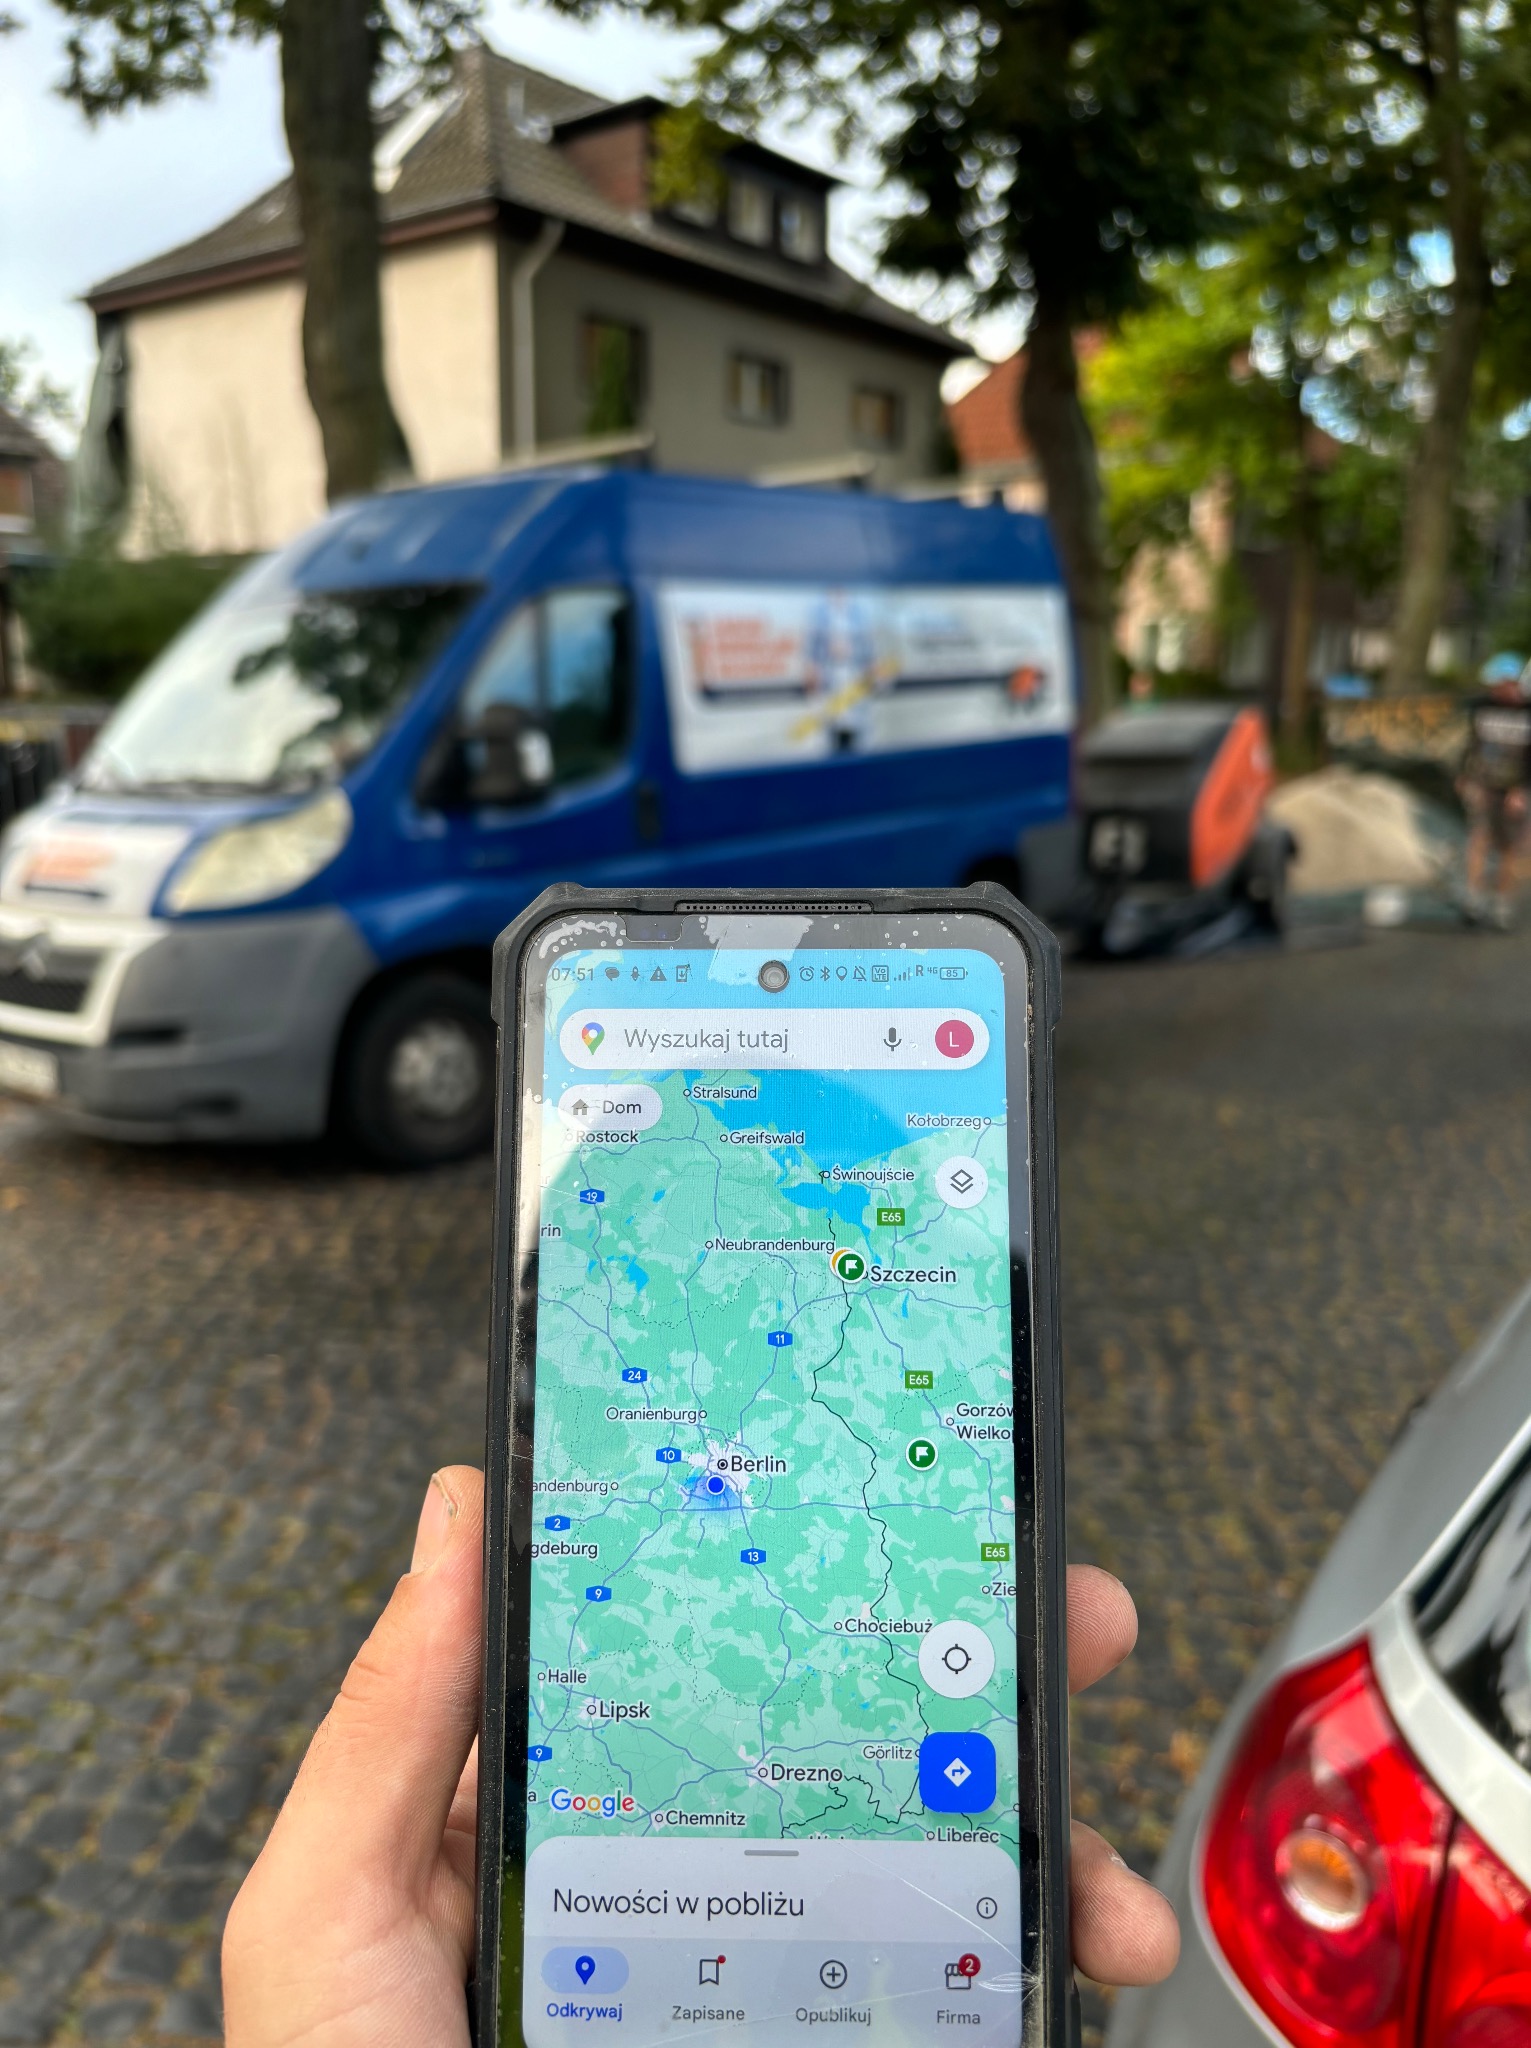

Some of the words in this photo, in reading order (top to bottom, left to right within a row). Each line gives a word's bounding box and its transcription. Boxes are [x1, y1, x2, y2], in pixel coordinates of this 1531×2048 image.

[551, 967, 594, 982] 07:51
[946, 969, 958, 978] 85
[624, 1028, 730, 1054] Wyszukaj
[737, 1028, 789, 1054] tutaj
[949, 1031, 960, 1048] L
[693, 1085, 757, 1099] Stralsund
[602, 1100, 642, 1114] Dom
[907, 1114, 982, 1129] Kołobrzeg
[576, 1130, 639, 1143] Rostock
[730, 1130, 804, 1145] Greifswald
[832, 1165, 915, 1184] Świnoujście
[586, 1191, 598, 1202] 19
[881, 1212, 902, 1223] E65
[715, 1236, 835, 1254] Neubrandenburg
[870, 1264, 957, 1285] Szczecin
[775, 1333, 785, 1344] 11
[628, 1370, 642, 1381] 24
[909, 1374, 930, 1386] E65
[606, 1406, 697, 1422] Oranienburg
[956, 1425, 1014, 1443] Wielko
[662, 1450, 675, 1461] 10
[731, 1455, 786, 1473] Berlin
[553, 1518, 561, 1529] 2
[748, 1551, 759, 1562] 13
[985, 1547, 1006, 1558] E65
[595, 1589, 602, 1599] 9
[845, 1618, 932, 1633] Chociebuż
[548, 1669, 587, 1684] Halle
[600, 1701, 650, 1722] Lipsk
[535, 1748, 543, 1759] 9
[863, 1745, 913, 1759] Görlitz
[772, 1765, 843, 1782] Drezno
[551, 1788, 635, 1818] Google
[666, 1810, 746, 1826] Chemnitz
[938, 1827, 999, 1843] Liberec
[553, 1889, 668, 1915] Nowości
[676, 1897, 699, 1915] w
[707, 1889, 804, 1921] pobliżu
[965, 1959, 974, 1973] 2
[546, 2003, 623, 2021] Odkrywaj
[672, 2005, 745, 2024] Zapisane
[795, 2006, 871, 2026] Opublikuj
[937, 2010, 981, 2025] Firma
